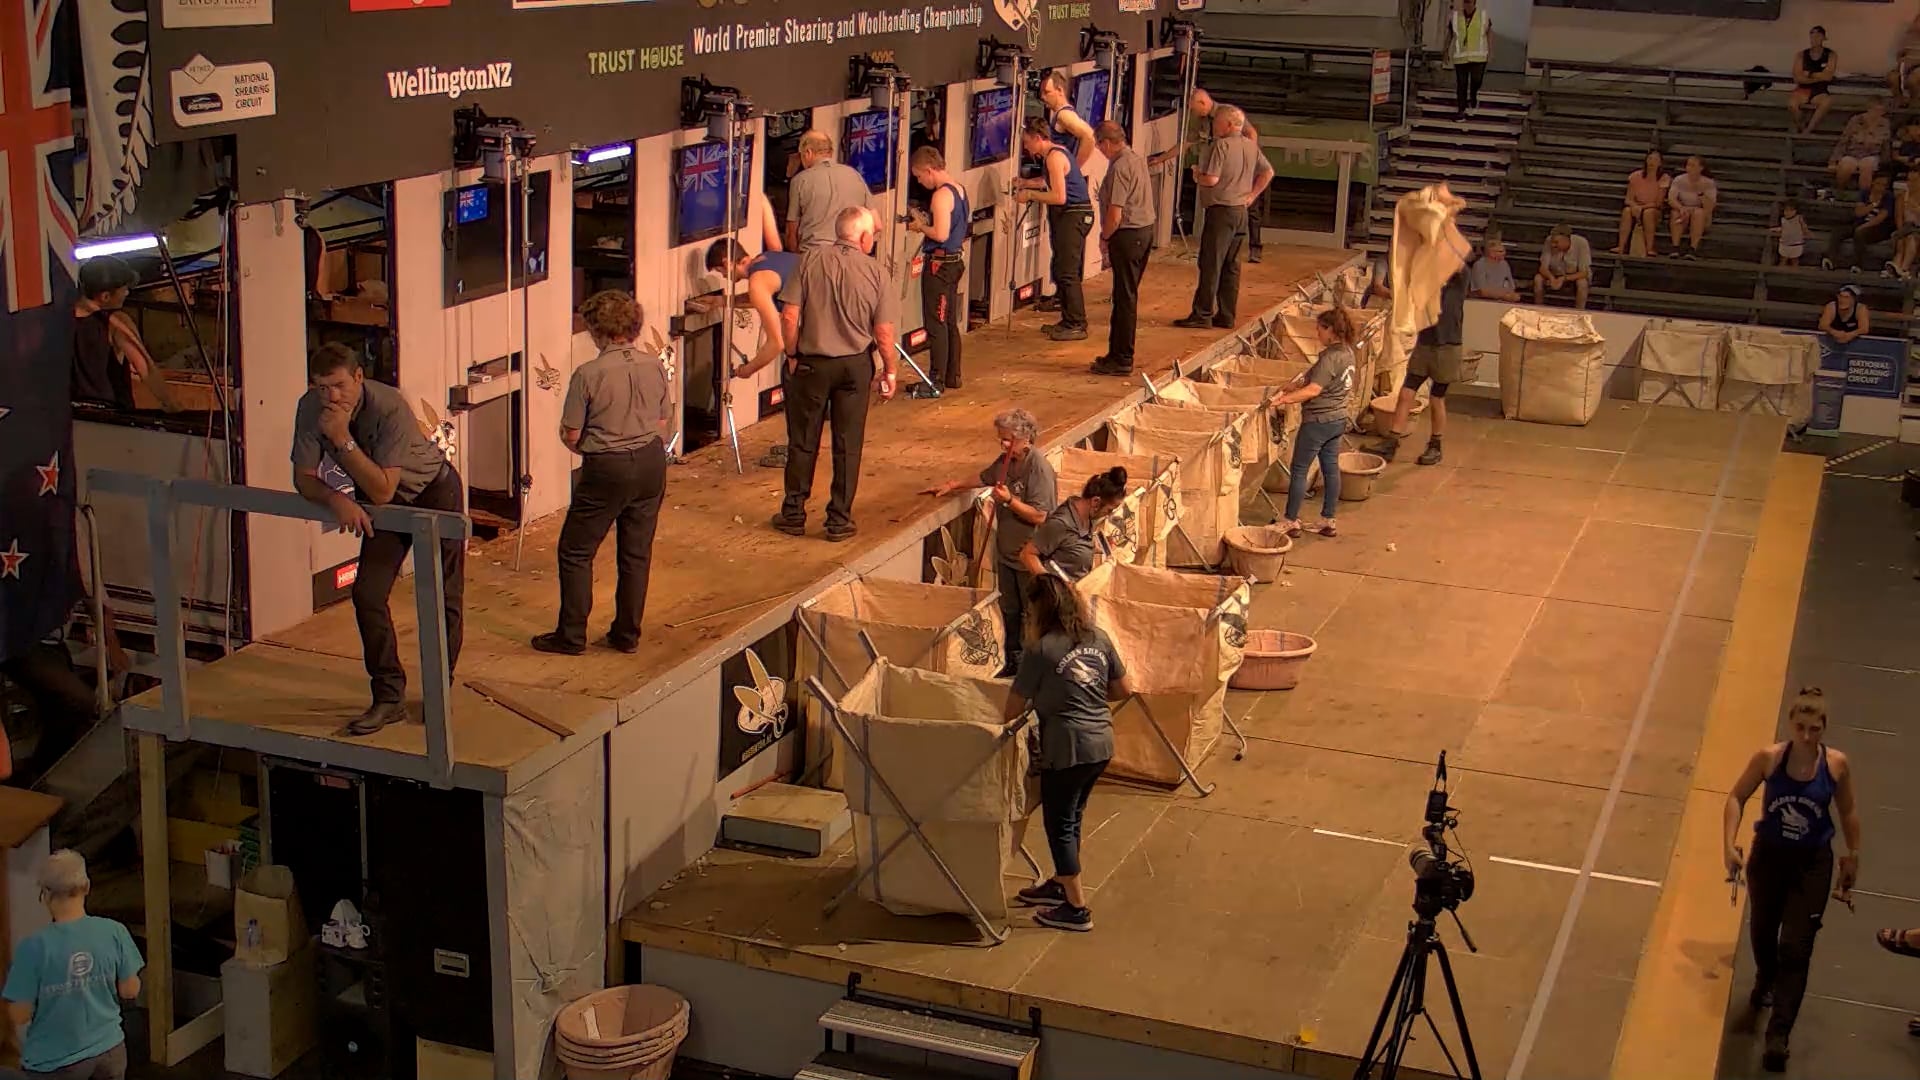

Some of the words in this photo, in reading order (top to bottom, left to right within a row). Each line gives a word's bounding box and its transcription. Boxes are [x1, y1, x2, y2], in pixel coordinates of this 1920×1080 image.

[1048, 4, 1068, 20] TRUST
[694, 25, 731, 55] World
[736, 22, 780, 50] Premier
[784, 17, 834, 44] Shearing
[836, 13, 855, 37] and
[858, 8, 921, 34] Woolhandling
[923, 2, 982, 30] Championship
[588, 49, 635, 75] TRUST
[640, 45, 685, 71] HOUSE
[234, 72, 269, 84] NATIONAL
[387, 62, 512, 99] WellingtonNZ
[235, 84, 270, 97] SHEARING
[235, 97, 262, 109] CIRCUIT
[1848, 360, 1889, 369] NATIONAL
[1848, 367, 1889, 377] SHEARING
[1847, 375, 1879, 384] CIRCUIT
[1056, 648, 1082, 674] GOLDEN
